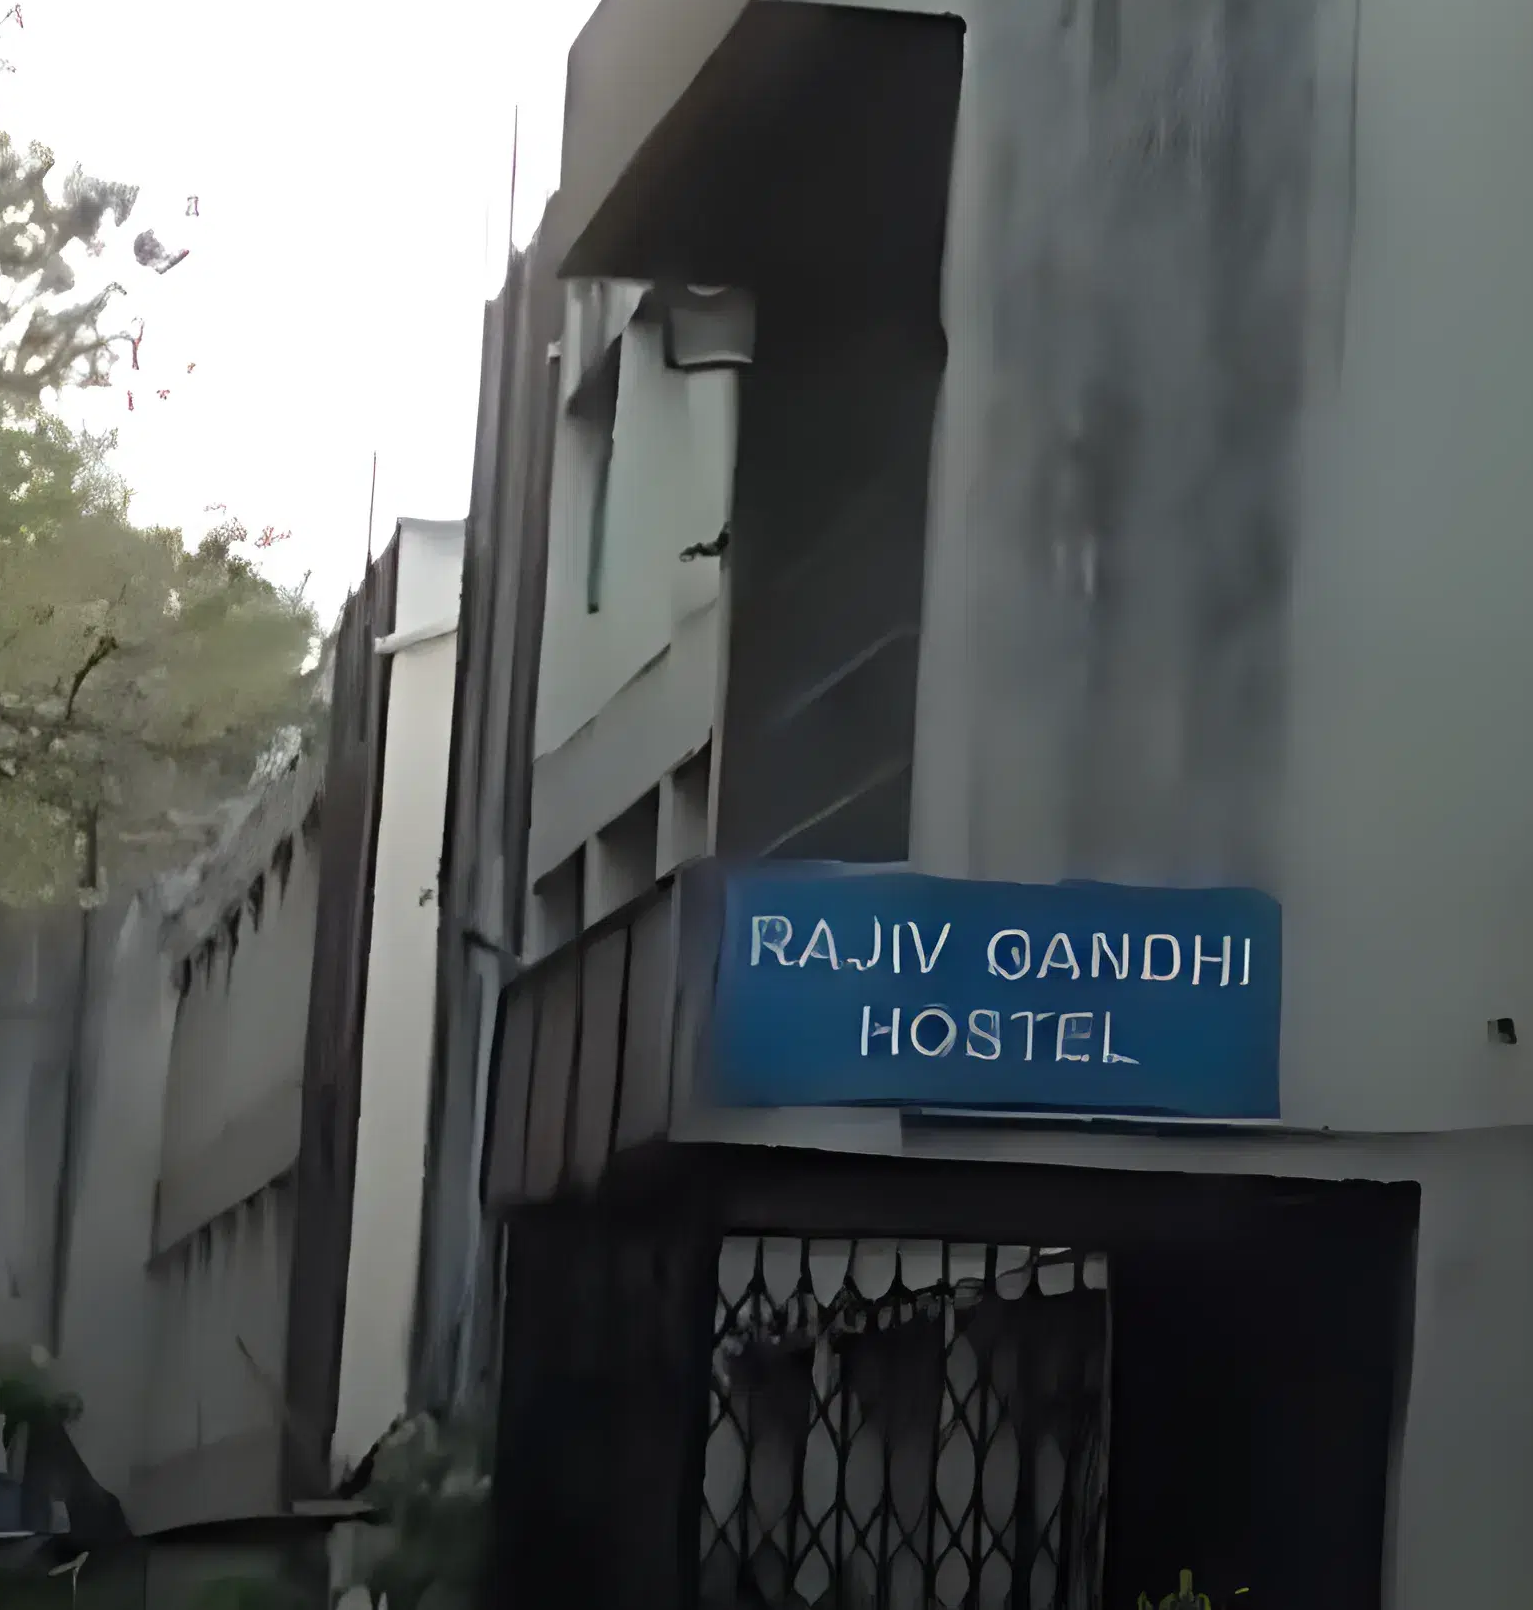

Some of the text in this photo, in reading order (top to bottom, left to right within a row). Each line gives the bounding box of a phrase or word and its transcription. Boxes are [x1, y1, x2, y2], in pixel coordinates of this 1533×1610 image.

[750, 915, 1251, 987] RAJIV GANDHI
[860, 1005, 1141, 1066] HOSTEL
